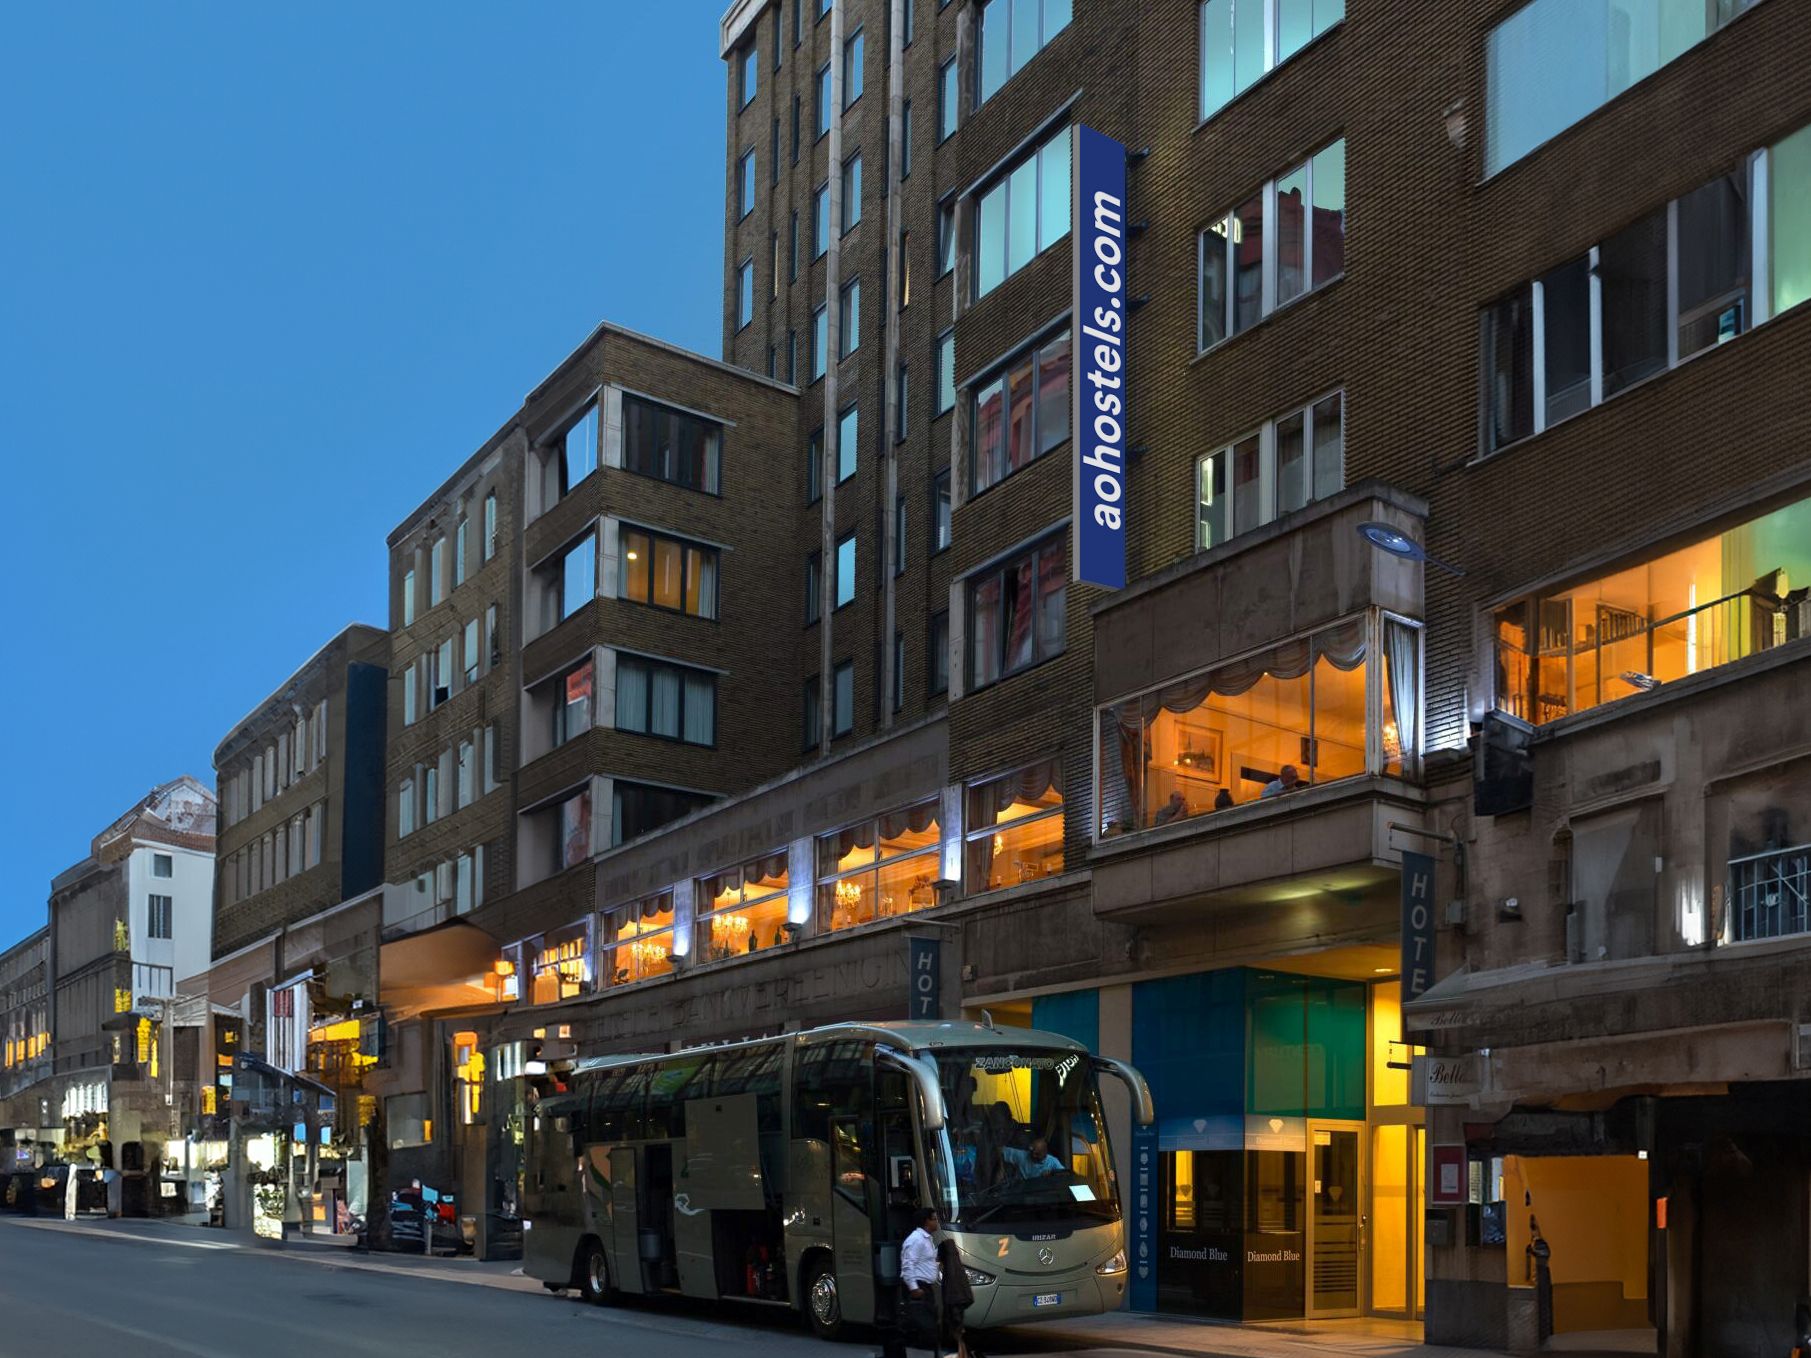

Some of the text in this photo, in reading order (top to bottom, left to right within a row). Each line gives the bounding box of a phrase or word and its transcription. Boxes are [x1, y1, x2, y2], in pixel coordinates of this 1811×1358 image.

[1082, 191, 1121, 530] aohostels.com
[1410, 872, 1428, 994] HOTE
[917, 952, 933, 1015] HOT
[975, 1056, 1055, 1070] ZANCONATO
[1170, 1246, 1228, 1261] Diamond Blue
[1247, 1249, 1300, 1262] Diamond Blue
